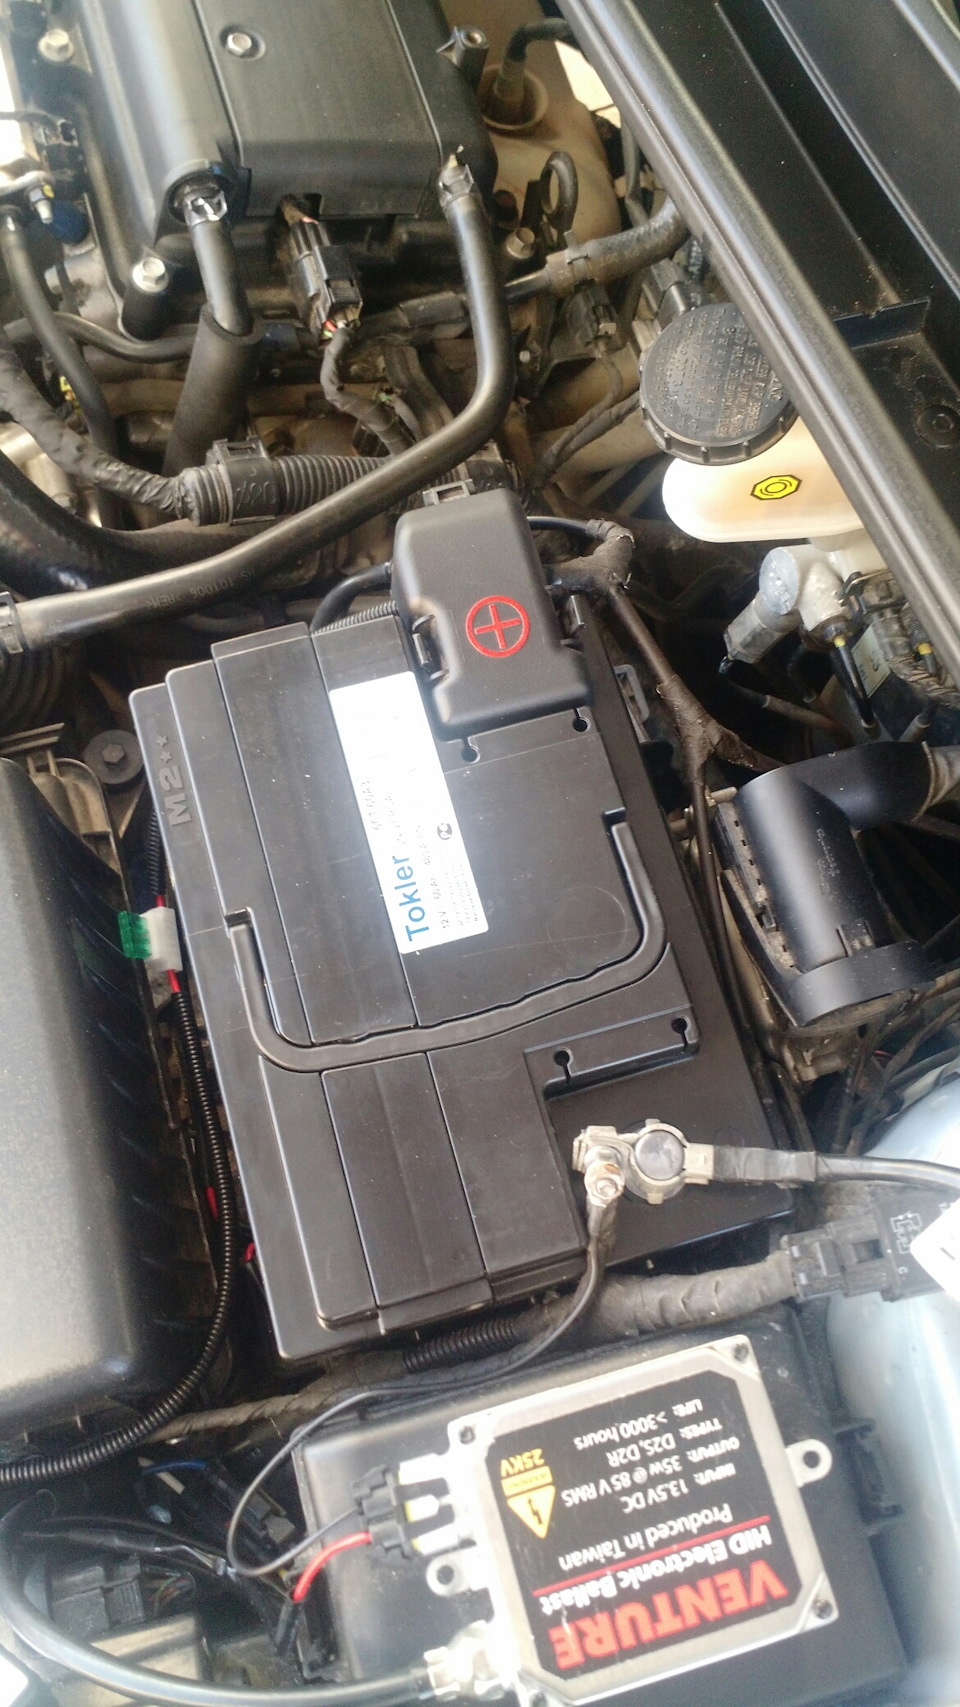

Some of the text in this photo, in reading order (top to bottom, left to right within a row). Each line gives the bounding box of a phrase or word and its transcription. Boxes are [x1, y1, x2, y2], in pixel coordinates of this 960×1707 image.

[391, 855, 430, 941] Tokler
[573, 1398, 703, 1451] LIFE: >3000 hours
[680, 1416, 723, 1439] TYPES:
[687, 1435, 740, 1461] OUTPUT:
[500, 1447, 545, 1476] 25KV
[605, 1444, 641, 1467] D2R
[561, 1483, 596, 1506] RMS
[620, 1462, 736, 1513] INPUT: 13.5V DC
[558, 1503, 733, 1571] Produced in Taiwan
[540, 1525, 771, 1616] HID Electronic Ballast
[548, 1559, 787, 1670] VENTURE
